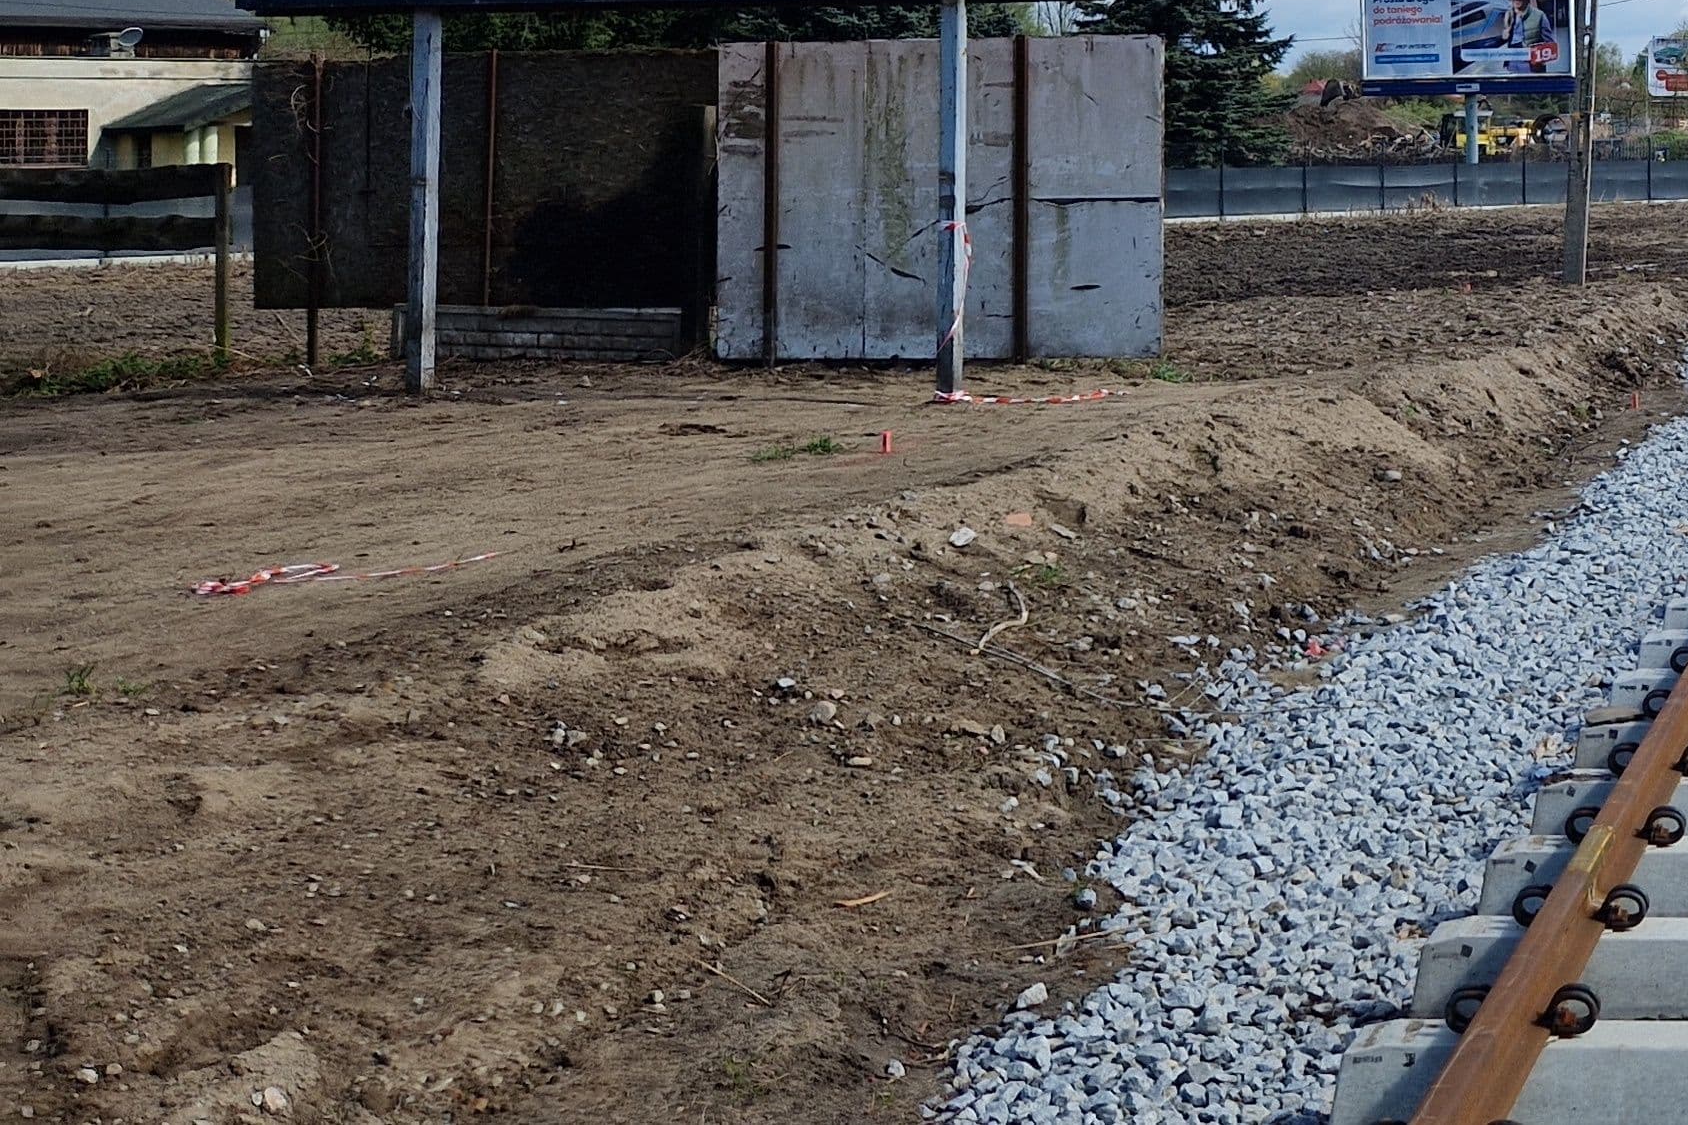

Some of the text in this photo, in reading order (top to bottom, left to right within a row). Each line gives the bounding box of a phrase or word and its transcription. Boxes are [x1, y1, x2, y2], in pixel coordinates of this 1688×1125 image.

[1373, 5, 1423, 16] do taniego
[1535, 47, 1551, 62] 19
